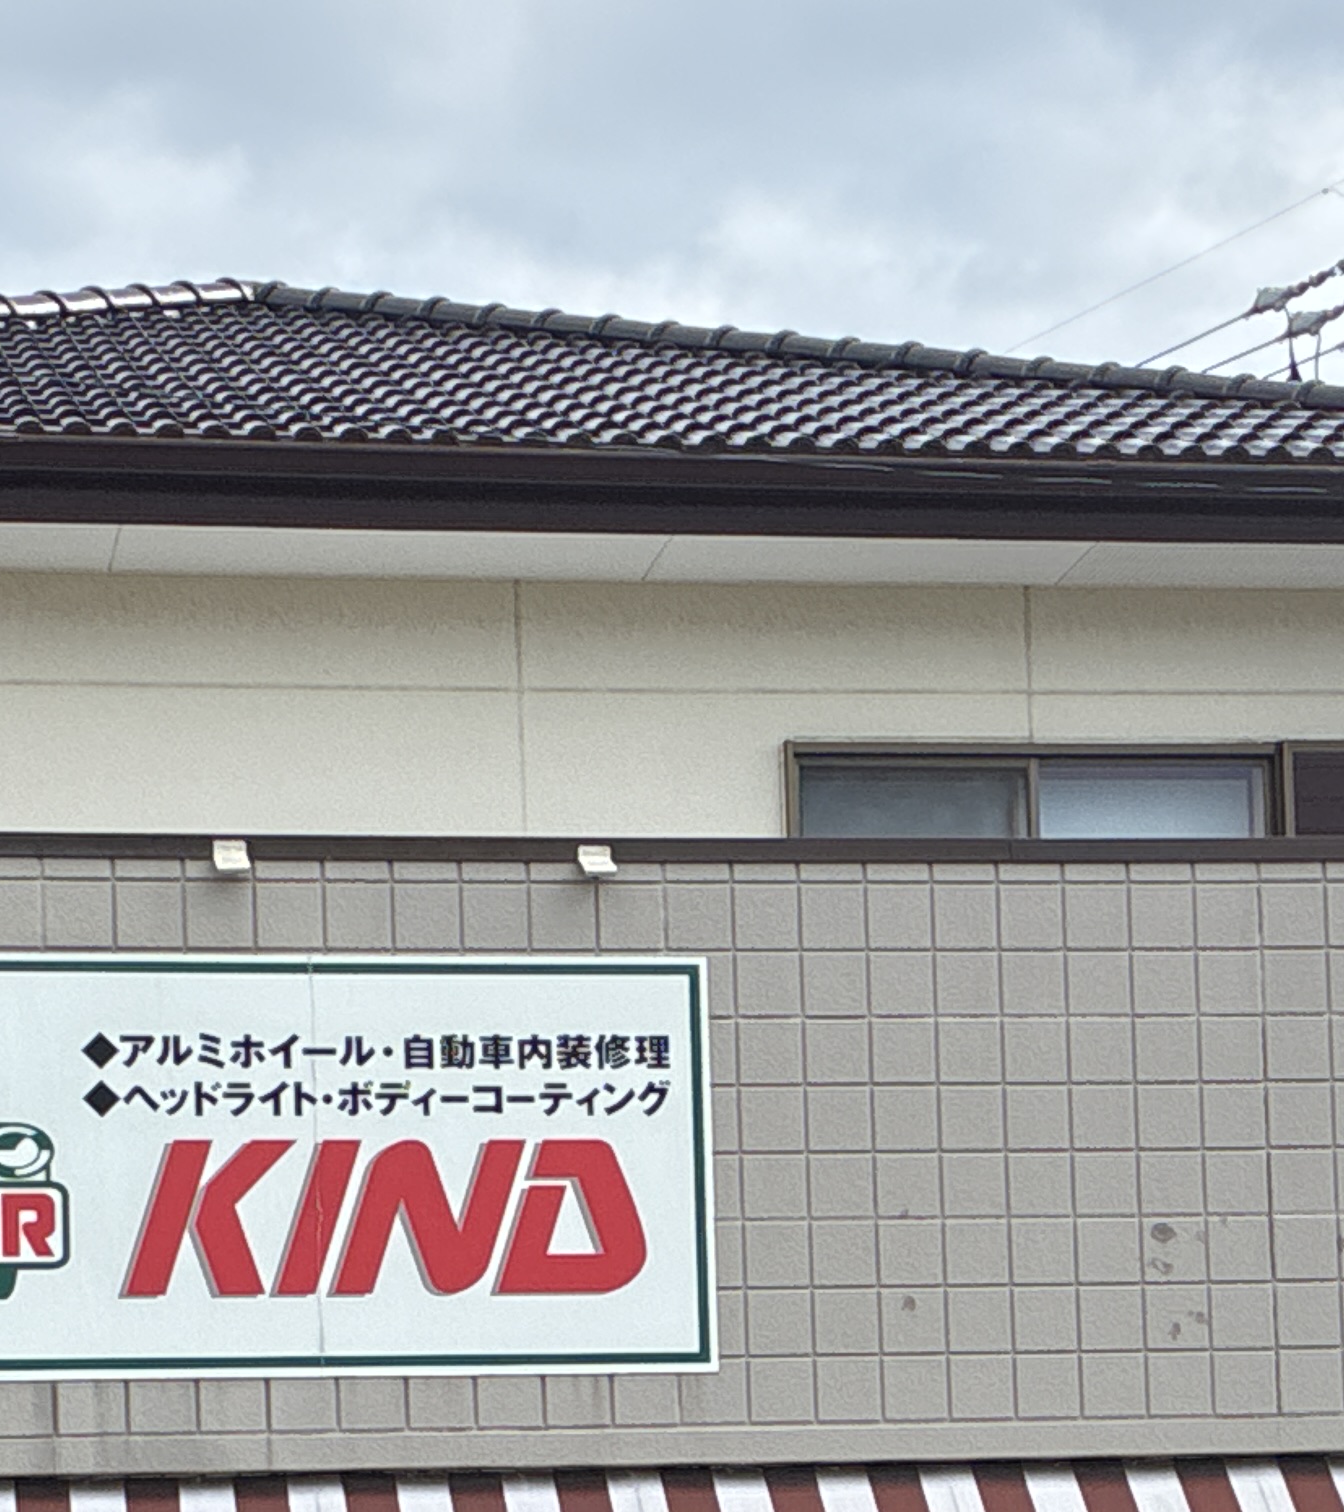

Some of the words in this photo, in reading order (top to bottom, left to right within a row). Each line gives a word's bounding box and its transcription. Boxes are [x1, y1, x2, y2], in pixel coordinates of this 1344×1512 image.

[118, 1033, 671, 1070] アルミホイール・自動車内装修理
[122, 1080, 670, 1117] ヘッドライト・ボディーコーティング
[119, 1139, 648, 1298] KIND
